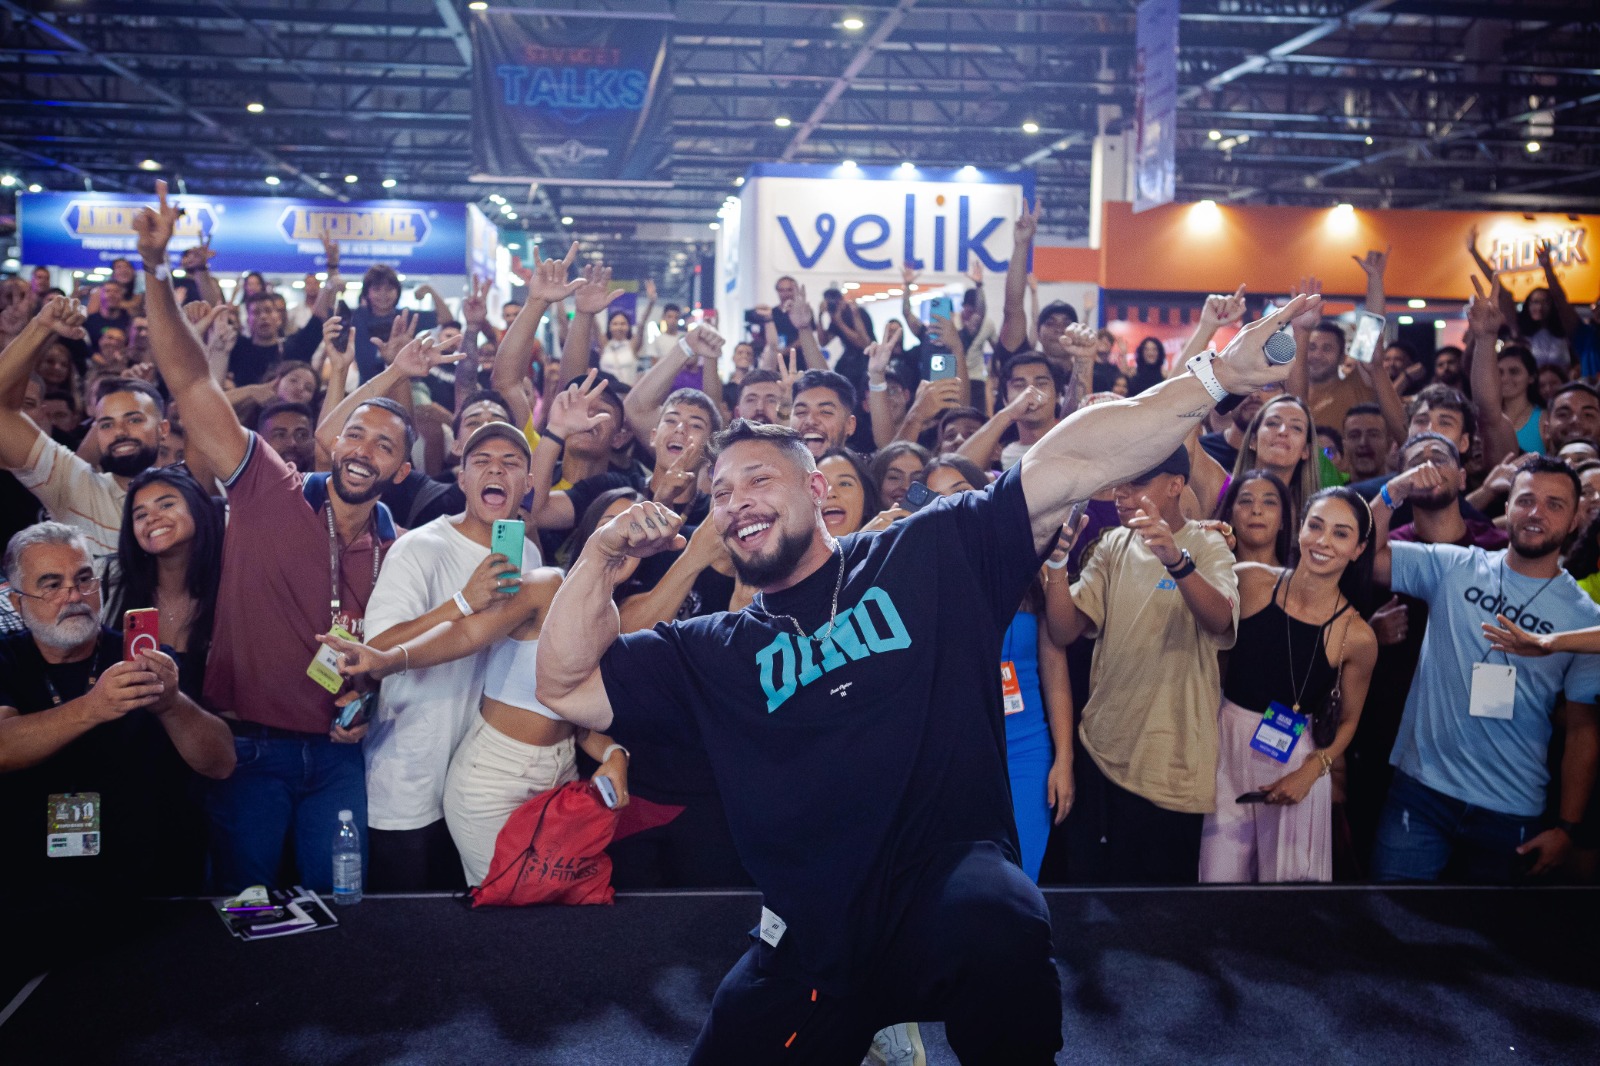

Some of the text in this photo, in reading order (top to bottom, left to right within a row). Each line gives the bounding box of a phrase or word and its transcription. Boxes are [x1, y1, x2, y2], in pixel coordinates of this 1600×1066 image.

[496, 64, 647, 109] TALKS
[776, 193, 1008, 273] velik
[1463, 586, 1555, 635] adidas
[755, 586, 913, 714] DINO
